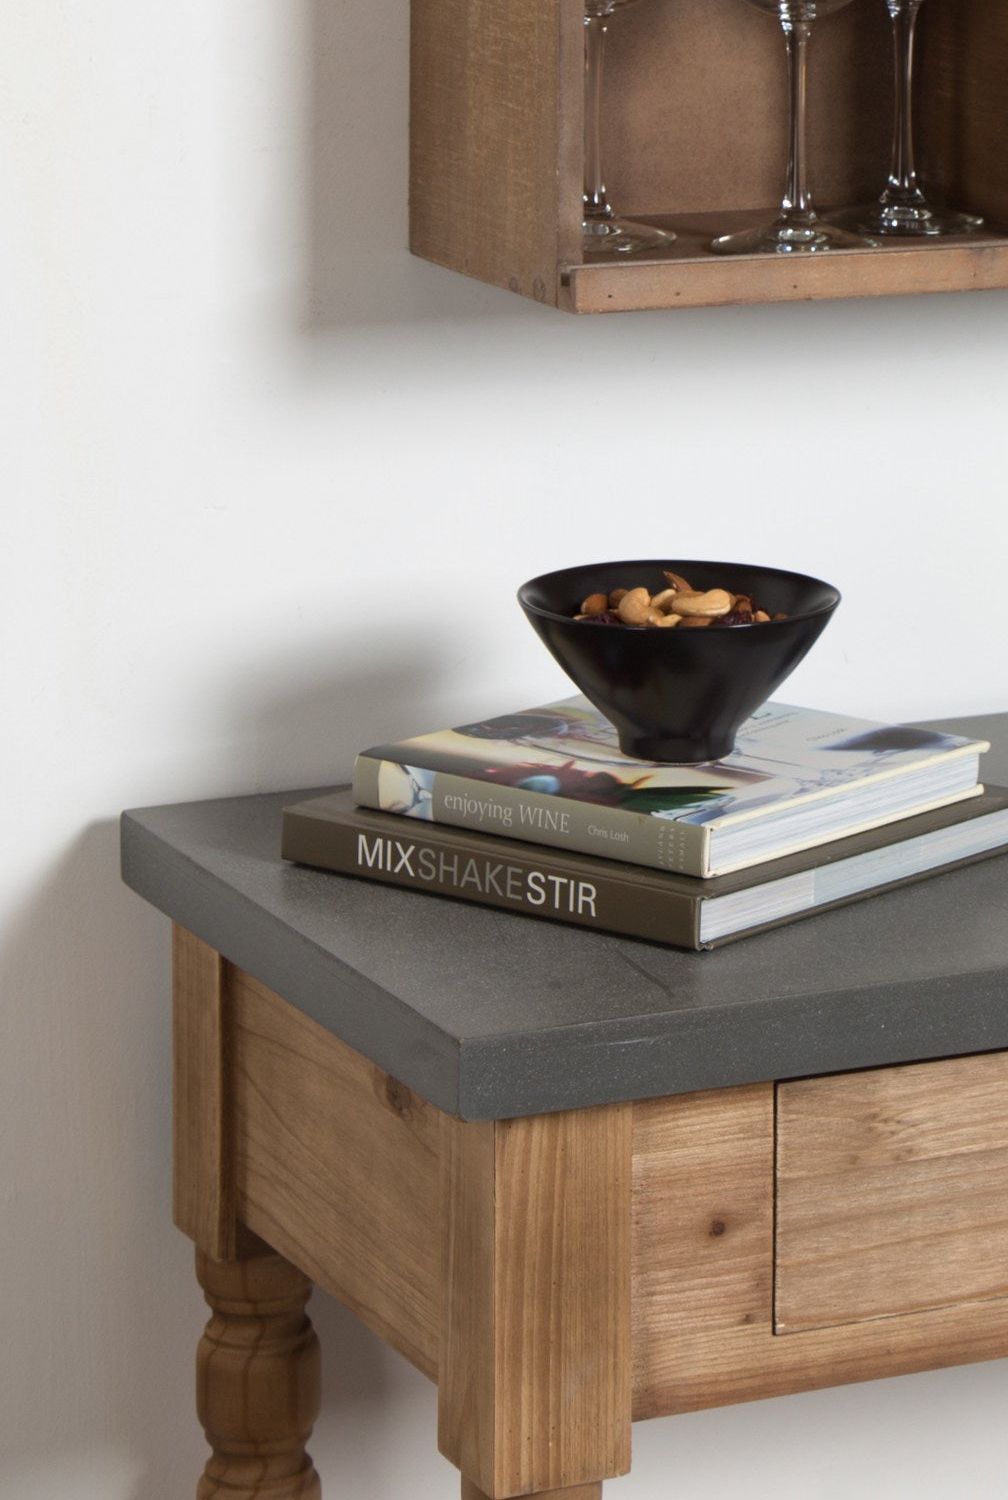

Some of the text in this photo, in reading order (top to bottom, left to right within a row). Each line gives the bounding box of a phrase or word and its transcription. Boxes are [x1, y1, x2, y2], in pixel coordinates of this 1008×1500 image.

[443, 793, 571, 835] enjoying WINE
[587, 824, 630, 843] Chris Losh
